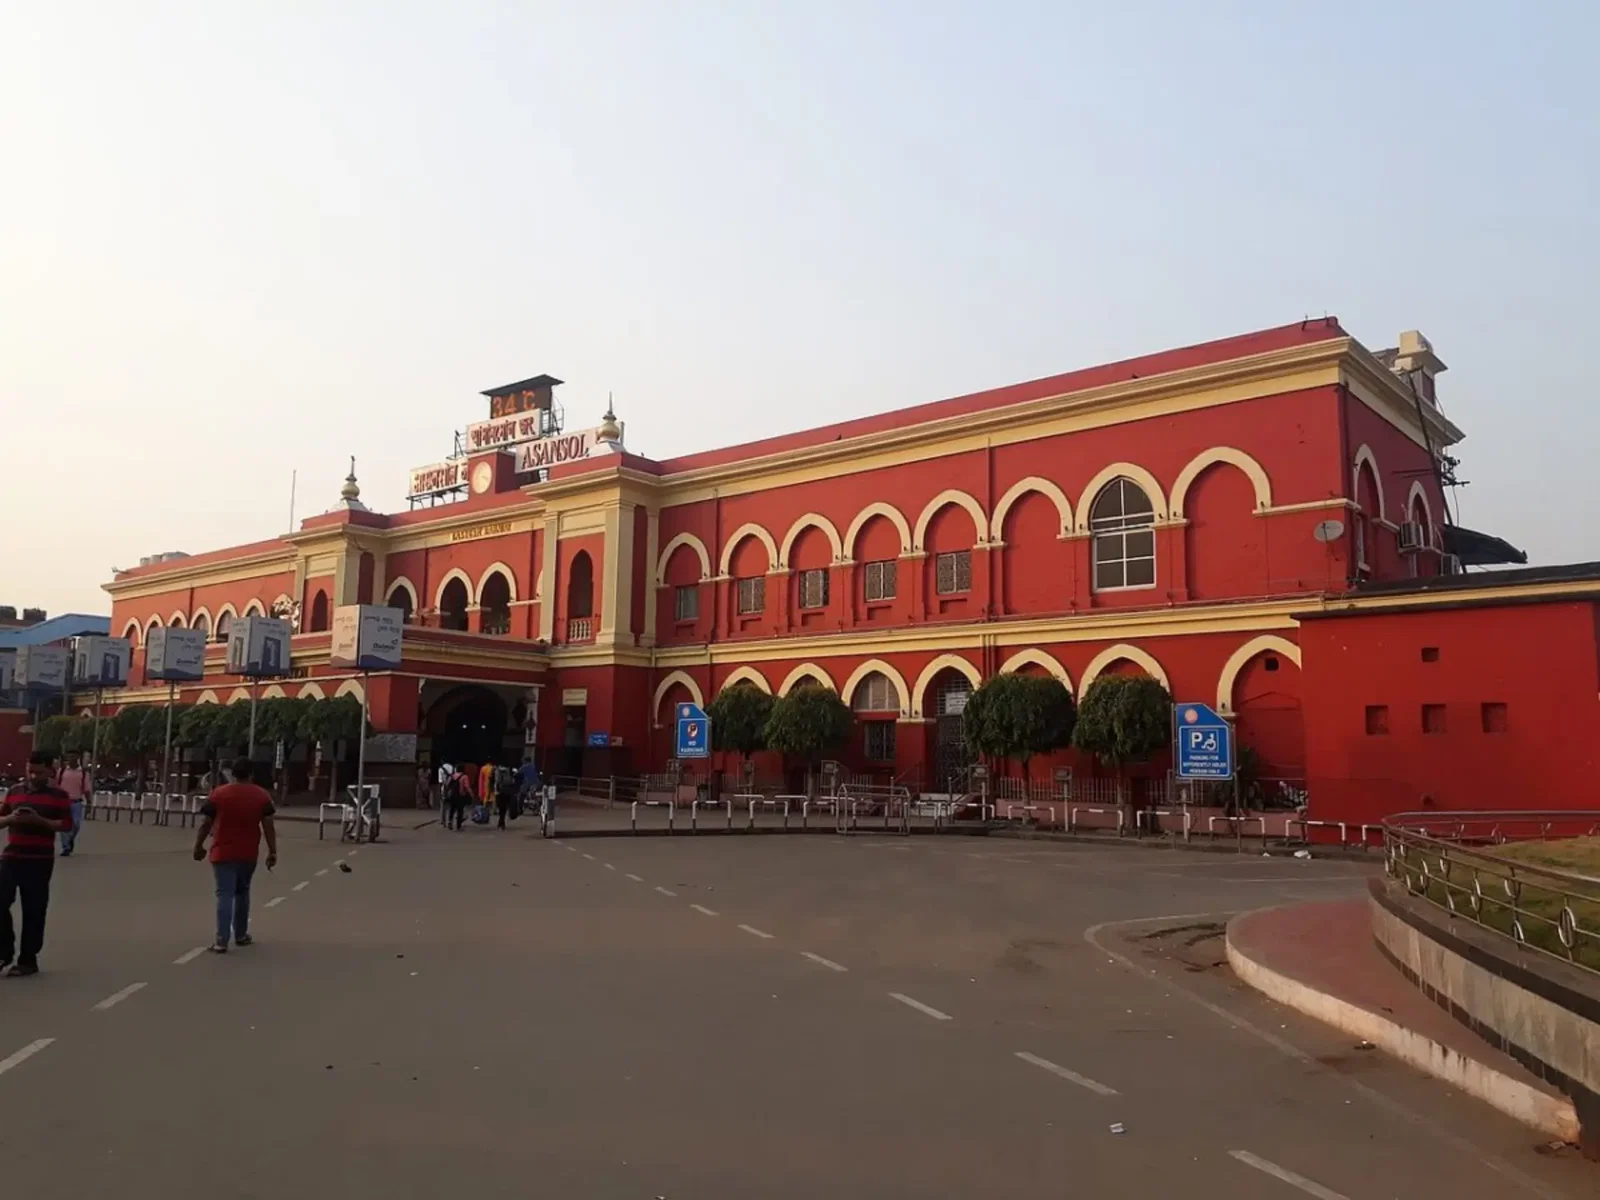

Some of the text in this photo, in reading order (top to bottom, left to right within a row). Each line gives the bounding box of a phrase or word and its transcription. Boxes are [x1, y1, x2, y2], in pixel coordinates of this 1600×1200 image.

[493, 394, 517, 418] 34
[521, 434, 589, 470] ASANSOL
[1191, 732, 1202, 748] P
